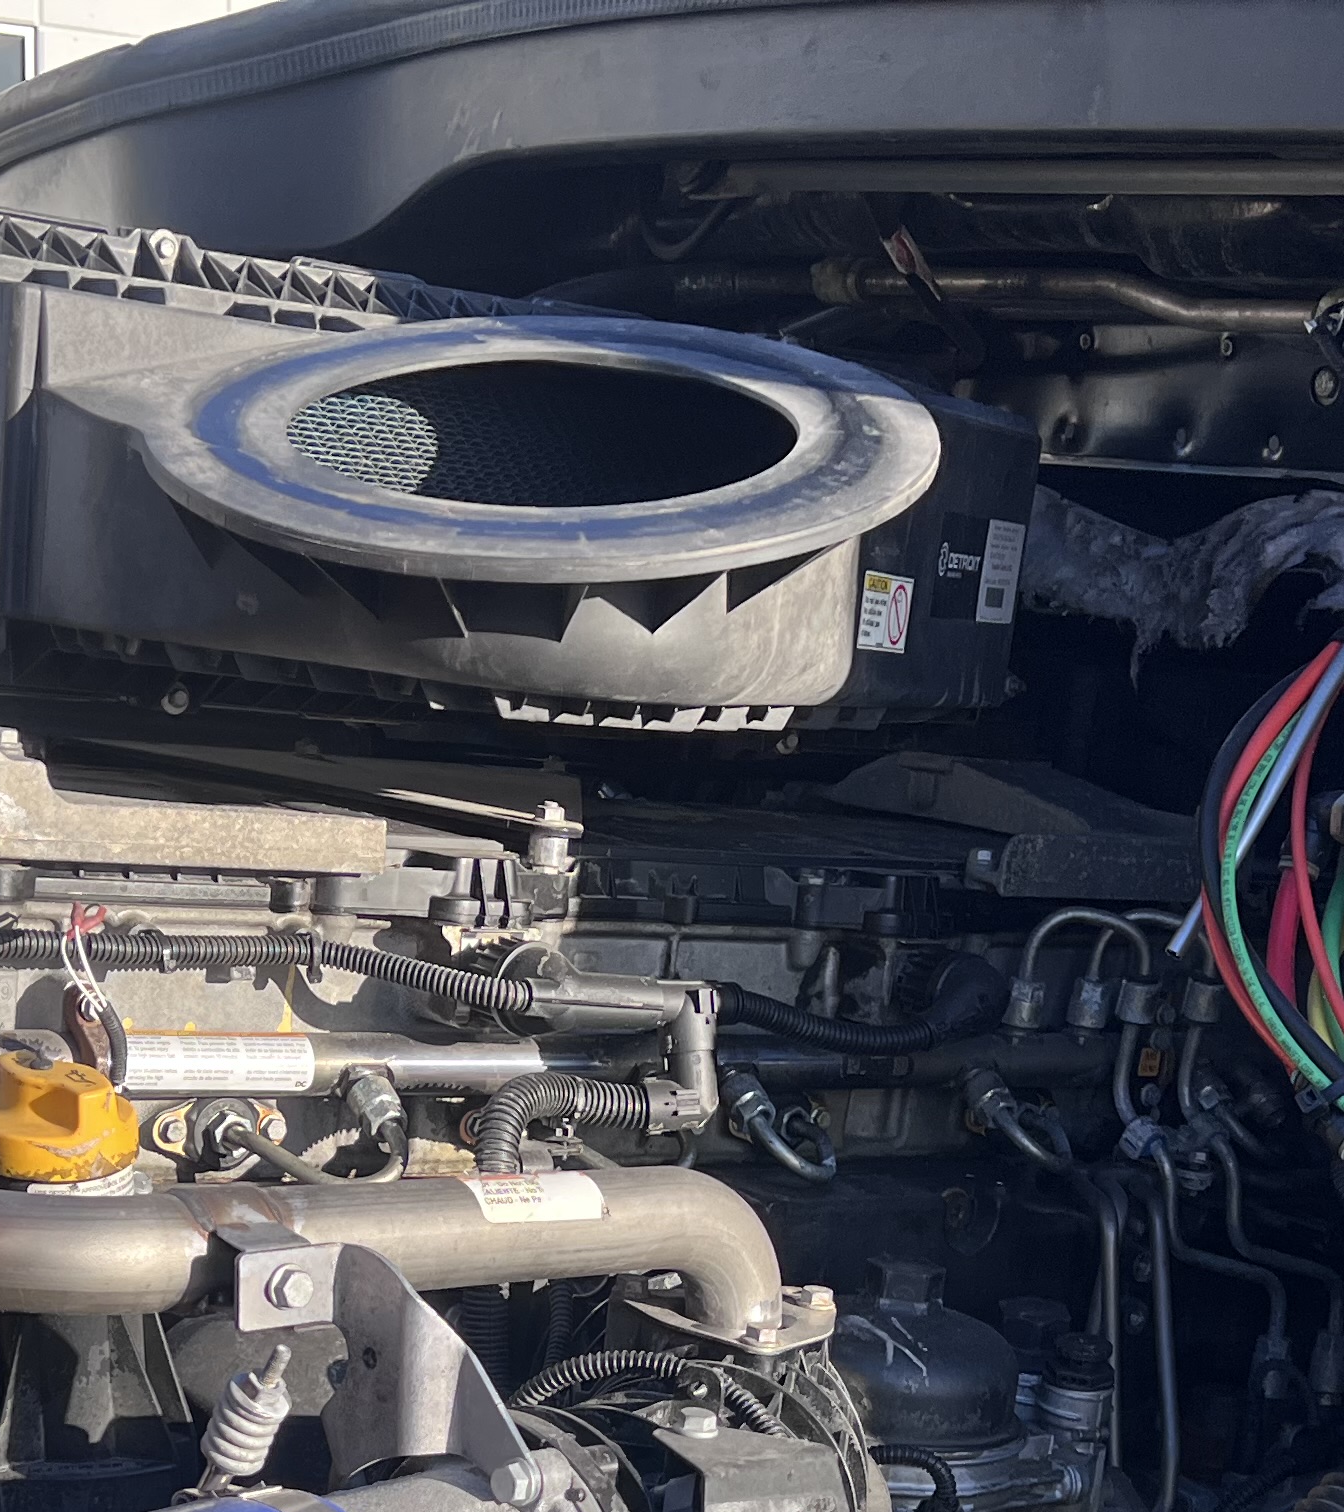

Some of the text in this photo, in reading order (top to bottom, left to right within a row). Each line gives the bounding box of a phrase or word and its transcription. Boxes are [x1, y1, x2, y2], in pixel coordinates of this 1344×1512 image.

[948, 553, 981, 572] DETROIT
[484, 1186, 520, 1196] ALIENTE
[484, 1197, 514, 1206] CHAUD
